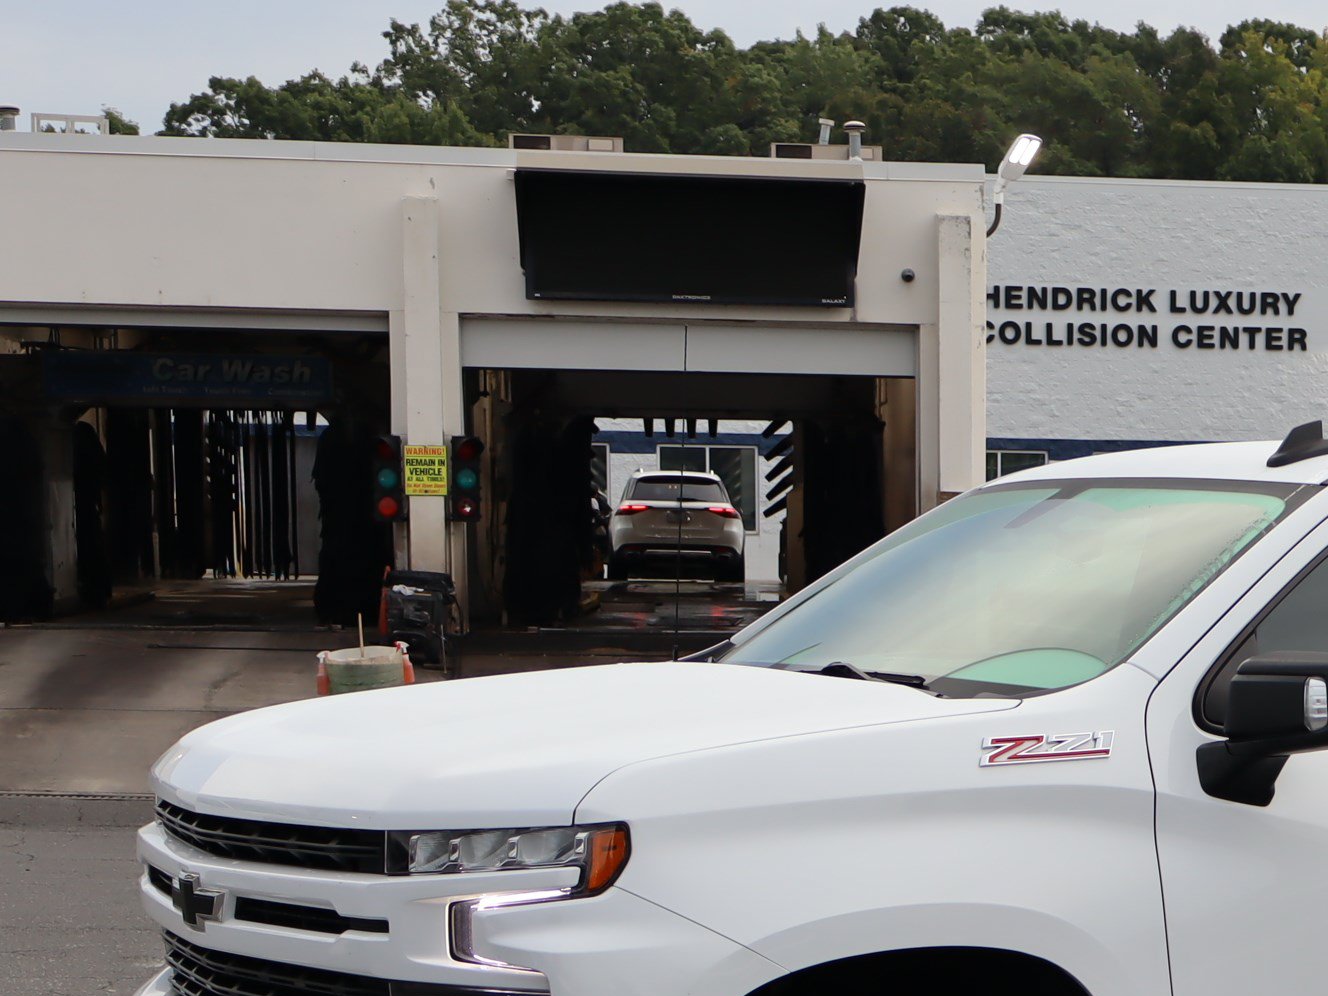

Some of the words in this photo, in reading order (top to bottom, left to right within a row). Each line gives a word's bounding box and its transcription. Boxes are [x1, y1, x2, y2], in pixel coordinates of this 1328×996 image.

[986, 285, 1157, 313] HENDRICK
[1169, 289, 1303, 316] LUXURY
[1171, 324, 1308, 352] CENTER
[152, 357, 211, 382] Car
[221, 358, 313, 384] Wash
[405, 447, 445, 456] WARNING!
[405, 458, 436, 467] REMAIN
[437, 458, 446, 467] IN
[409, 467, 443, 476] VEHICLE
[979, 730, 1115, 768] Z71
